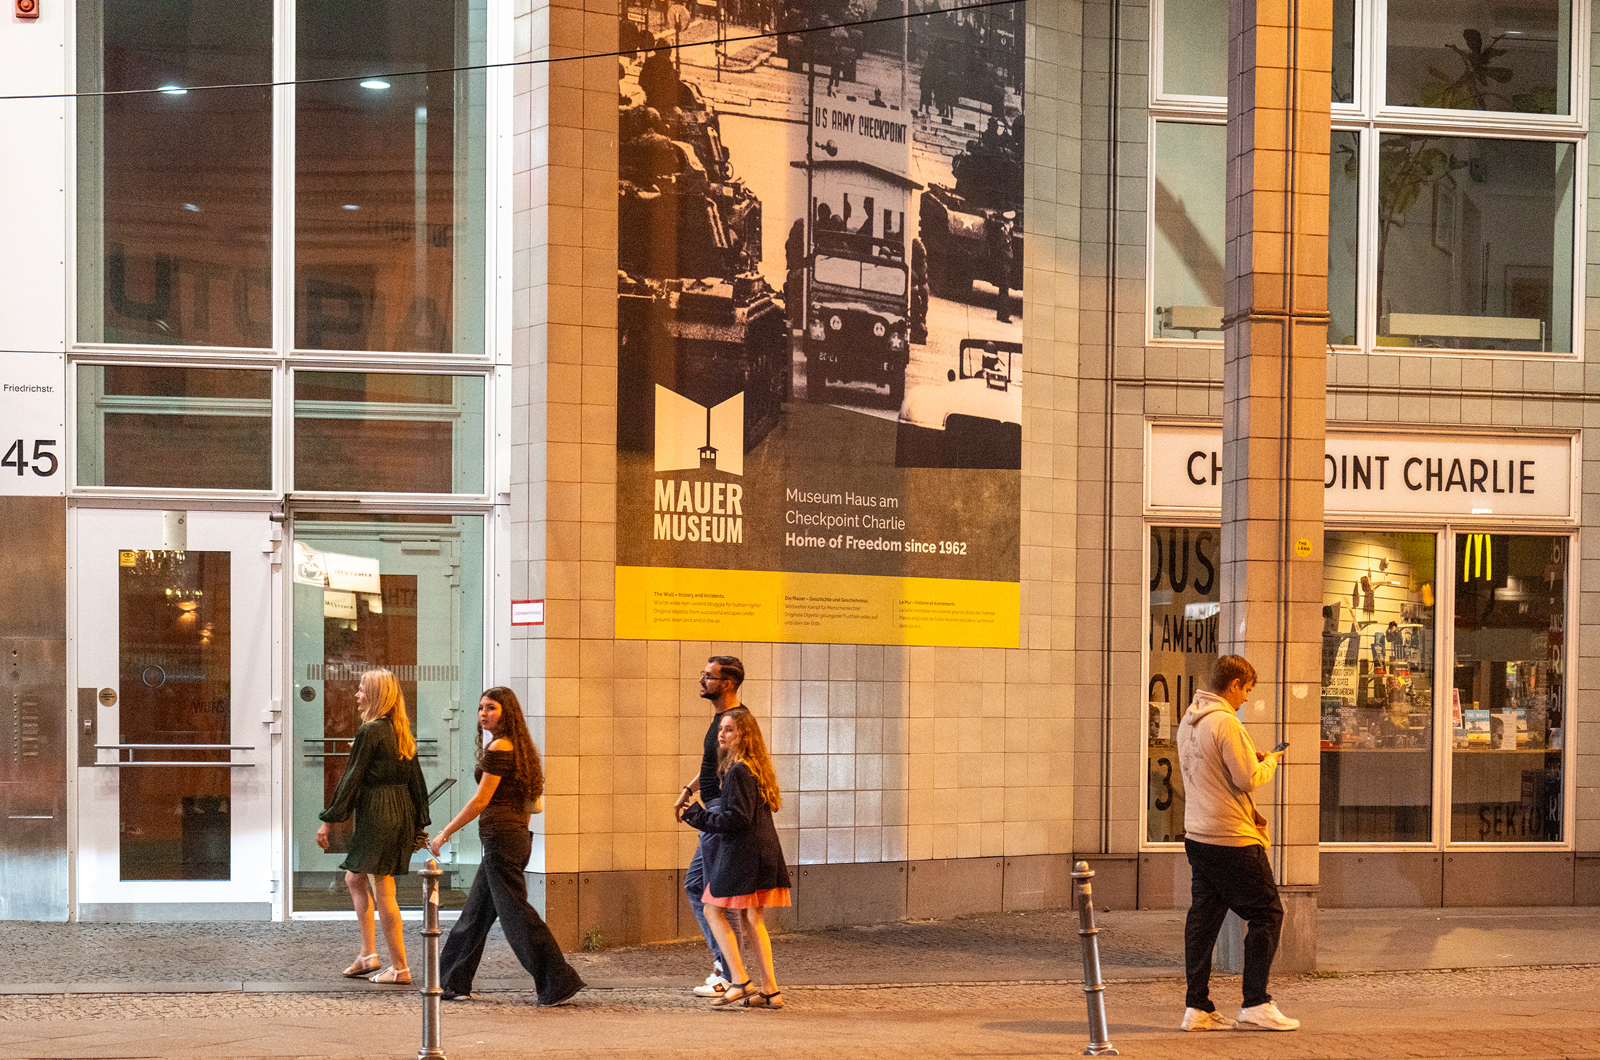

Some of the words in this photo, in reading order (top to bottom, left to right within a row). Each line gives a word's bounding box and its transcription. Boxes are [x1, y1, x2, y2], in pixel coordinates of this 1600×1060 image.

[831, 109, 856, 133] ARMY
[858, 115, 908, 145] CHECKPOINT
[3, 383, 55, 394] Friedrichstr.
[0, 438, 59, 478] 45
[1403, 456, 1536, 494] CHARLIE
[654, 479, 743, 515] MAUER
[785, 488, 843, 505] Museum
[845, 491, 877, 508] Haus
[879, 496, 899, 509] am
[653, 515, 743, 544] MUSEUM
[785, 510, 860, 529] Checkpoint
[862, 514, 906, 531] Charlie
[785, 532, 827, 549] Home
[828, 534, 843, 549] of
[846, 535, 903, 553] Freedom
[904, 540, 937, 555] since
[938, 540, 967, 556] 1962
